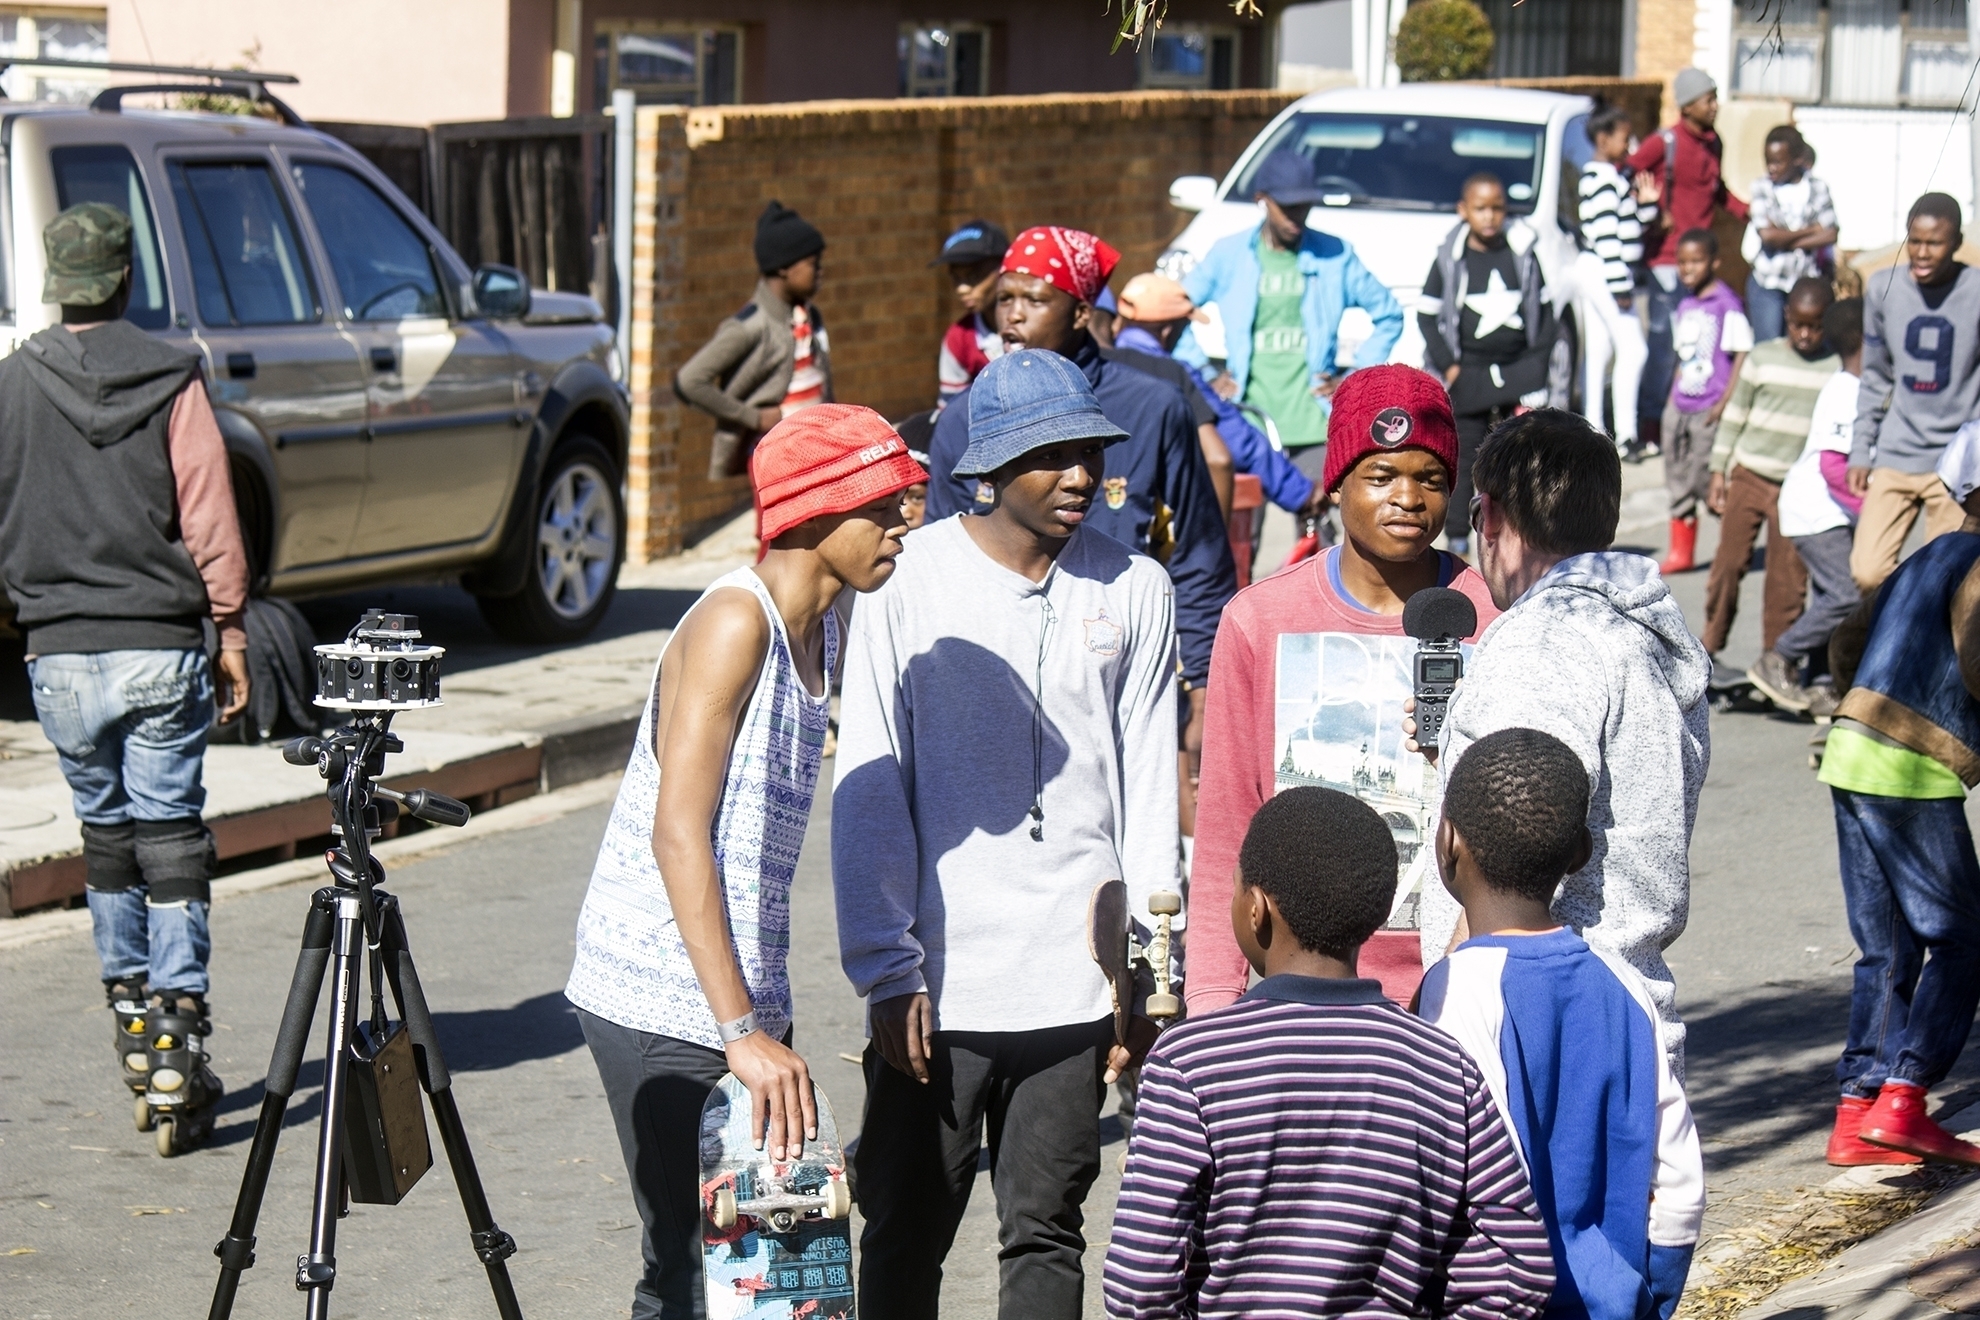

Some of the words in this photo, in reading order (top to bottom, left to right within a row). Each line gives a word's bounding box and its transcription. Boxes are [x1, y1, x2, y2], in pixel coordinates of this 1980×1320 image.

[1902, 315, 1954, 394] 9
[860, 439, 899, 465] RELAY
[800, 1250, 828, 1261] TOWN
